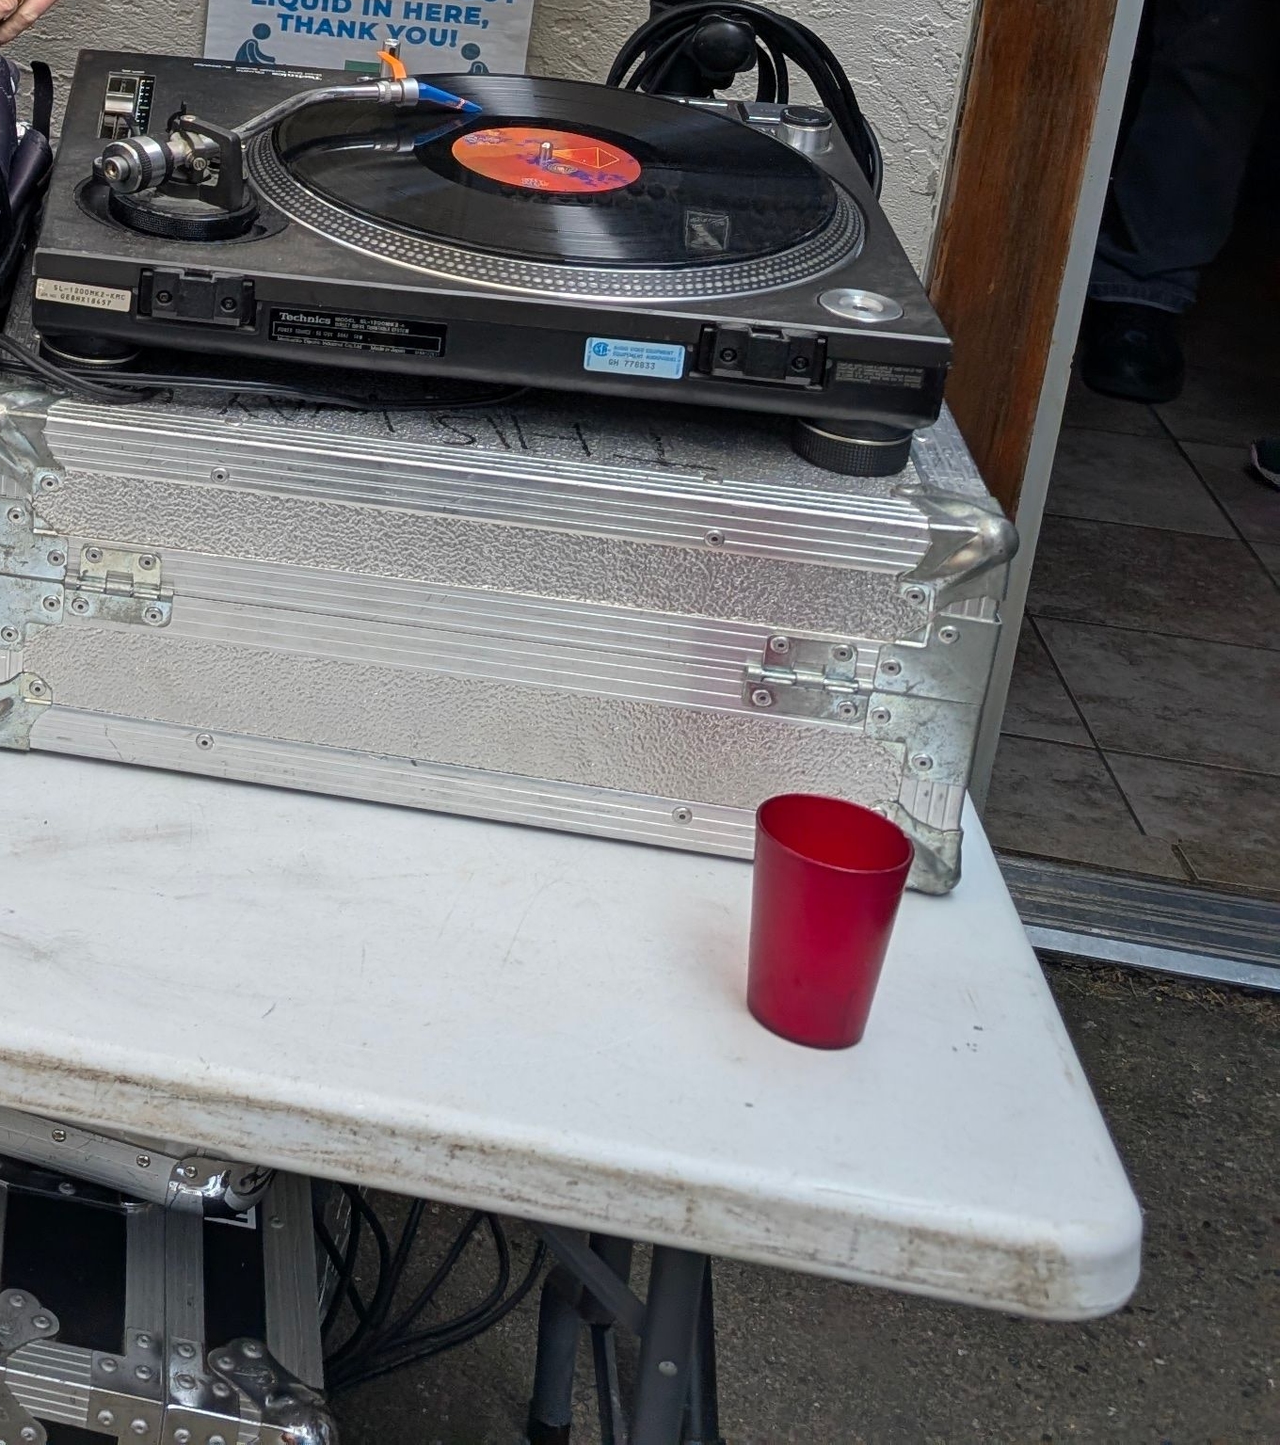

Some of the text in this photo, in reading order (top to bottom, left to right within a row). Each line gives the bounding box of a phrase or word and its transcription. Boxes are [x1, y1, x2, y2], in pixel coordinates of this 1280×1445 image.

[403, 1, 490, 29] HERE,
[277, 13, 458, 48] THANK YOU!
[279, 311, 331, 325] Technics
